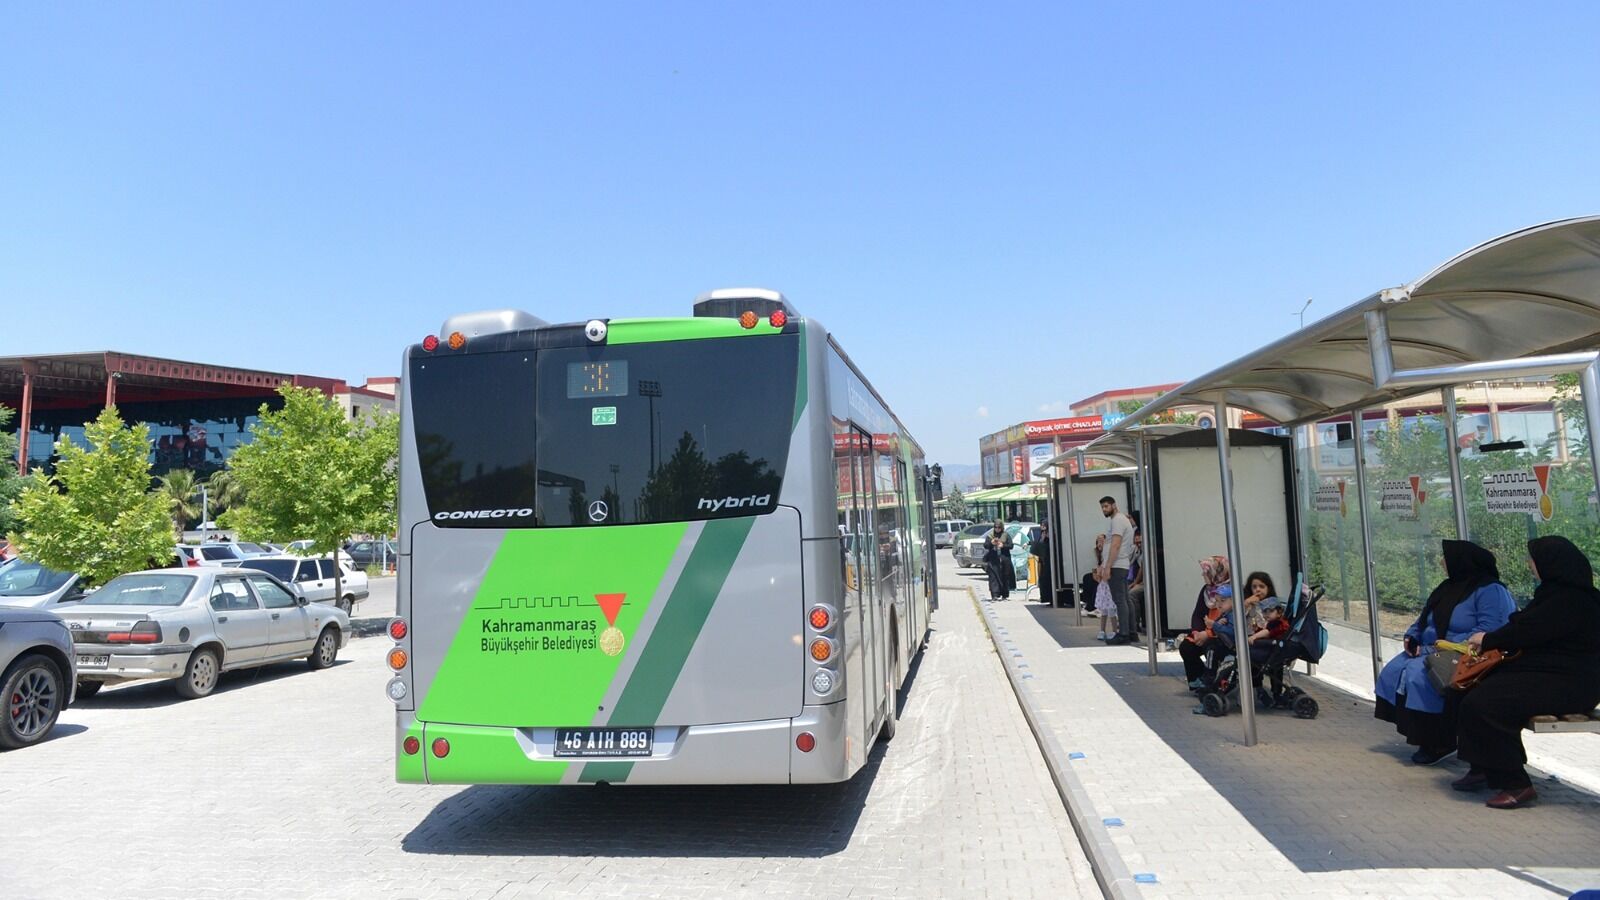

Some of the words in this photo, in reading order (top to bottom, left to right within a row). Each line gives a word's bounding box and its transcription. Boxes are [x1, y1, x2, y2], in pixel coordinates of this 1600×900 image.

[697, 493, 771, 511] hybrid
[1485, 487, 1537, 500] Kahramanmaraş
[434, 507, 533, 520] CONECTO
[482, 618, 597, 634] Kahramanmaraş
[481, 637, 539, 654] Büyükşehir
[542, 635, 597, 653] Belediyesi
[563, 732, 582, 749] 46
[587, 732, 614, 749] AIH
[620, 731, 647, 749] 889
